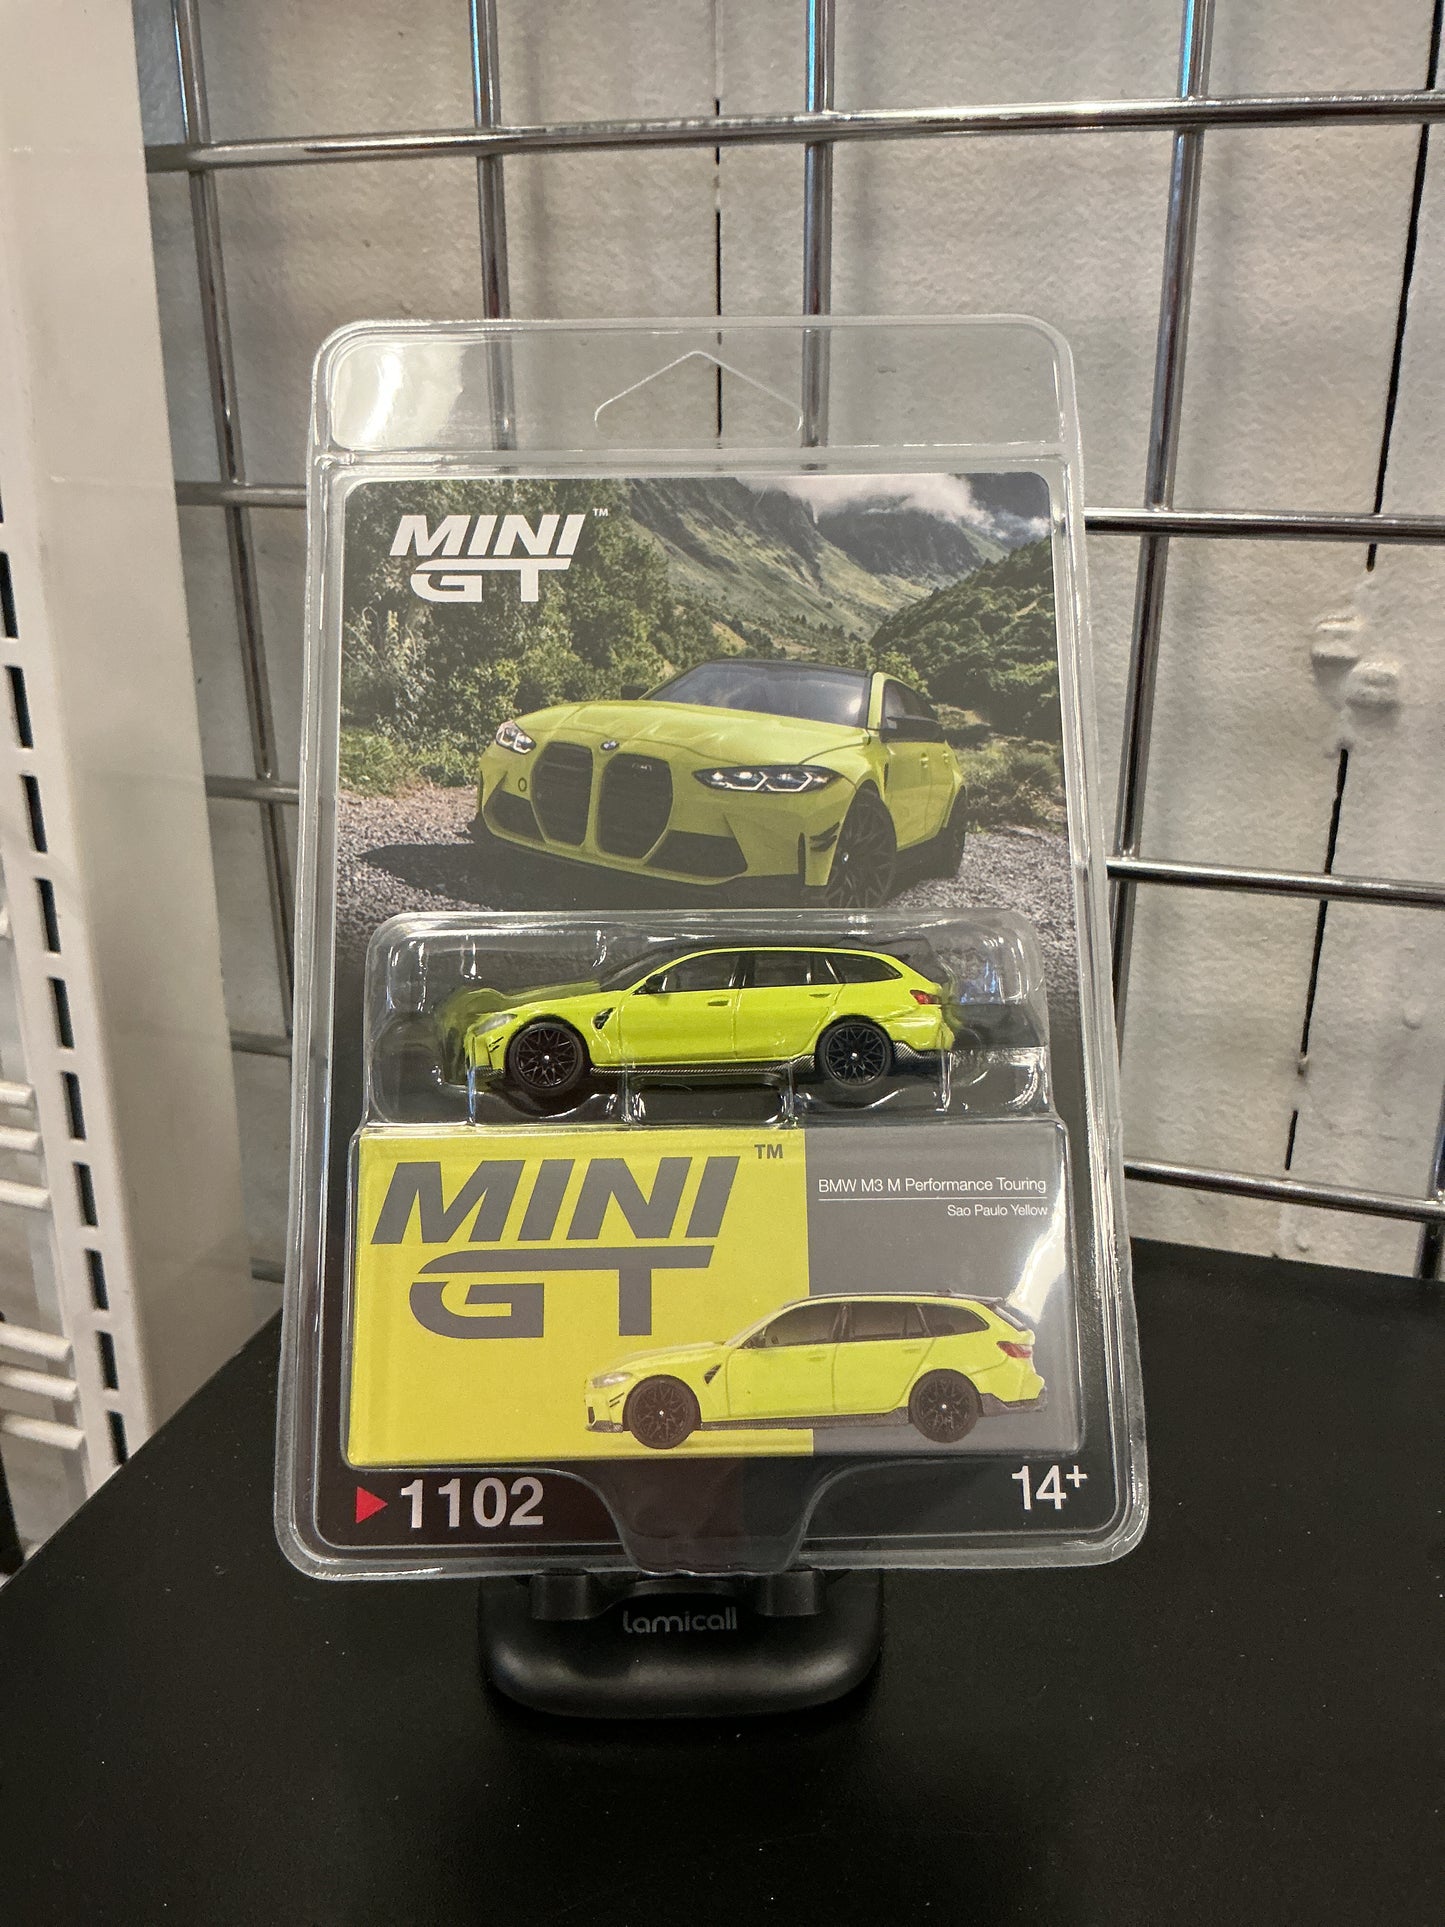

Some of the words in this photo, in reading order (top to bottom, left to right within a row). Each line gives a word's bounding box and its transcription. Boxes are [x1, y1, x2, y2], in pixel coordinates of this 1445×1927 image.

[389, 514, 586, 556] MINI
[410, 558, 572, 603] GT
[370, 1155, 741, 1244] MINI
[818, 1179, 857, 1193] BMW
[861, 1178, 883, 1193] M3
[888, 1178, 901, 1192] M
[905, 1177, 993, 1192] Performance
[996, 1177, 1046, 1194] Touring
[947, 1204, 971, 1217] Sao
[974, 1204, 1008, 1216] Paulo
[1010, 1203, 1048, 1216] Yellow
[409, 1245, 715, 1340] GT
[400, 1476, 544, 1529] 1102
[1011, 1465, 1088, 1510] 14+
[622, 1606, 737, 1634] lamicall
